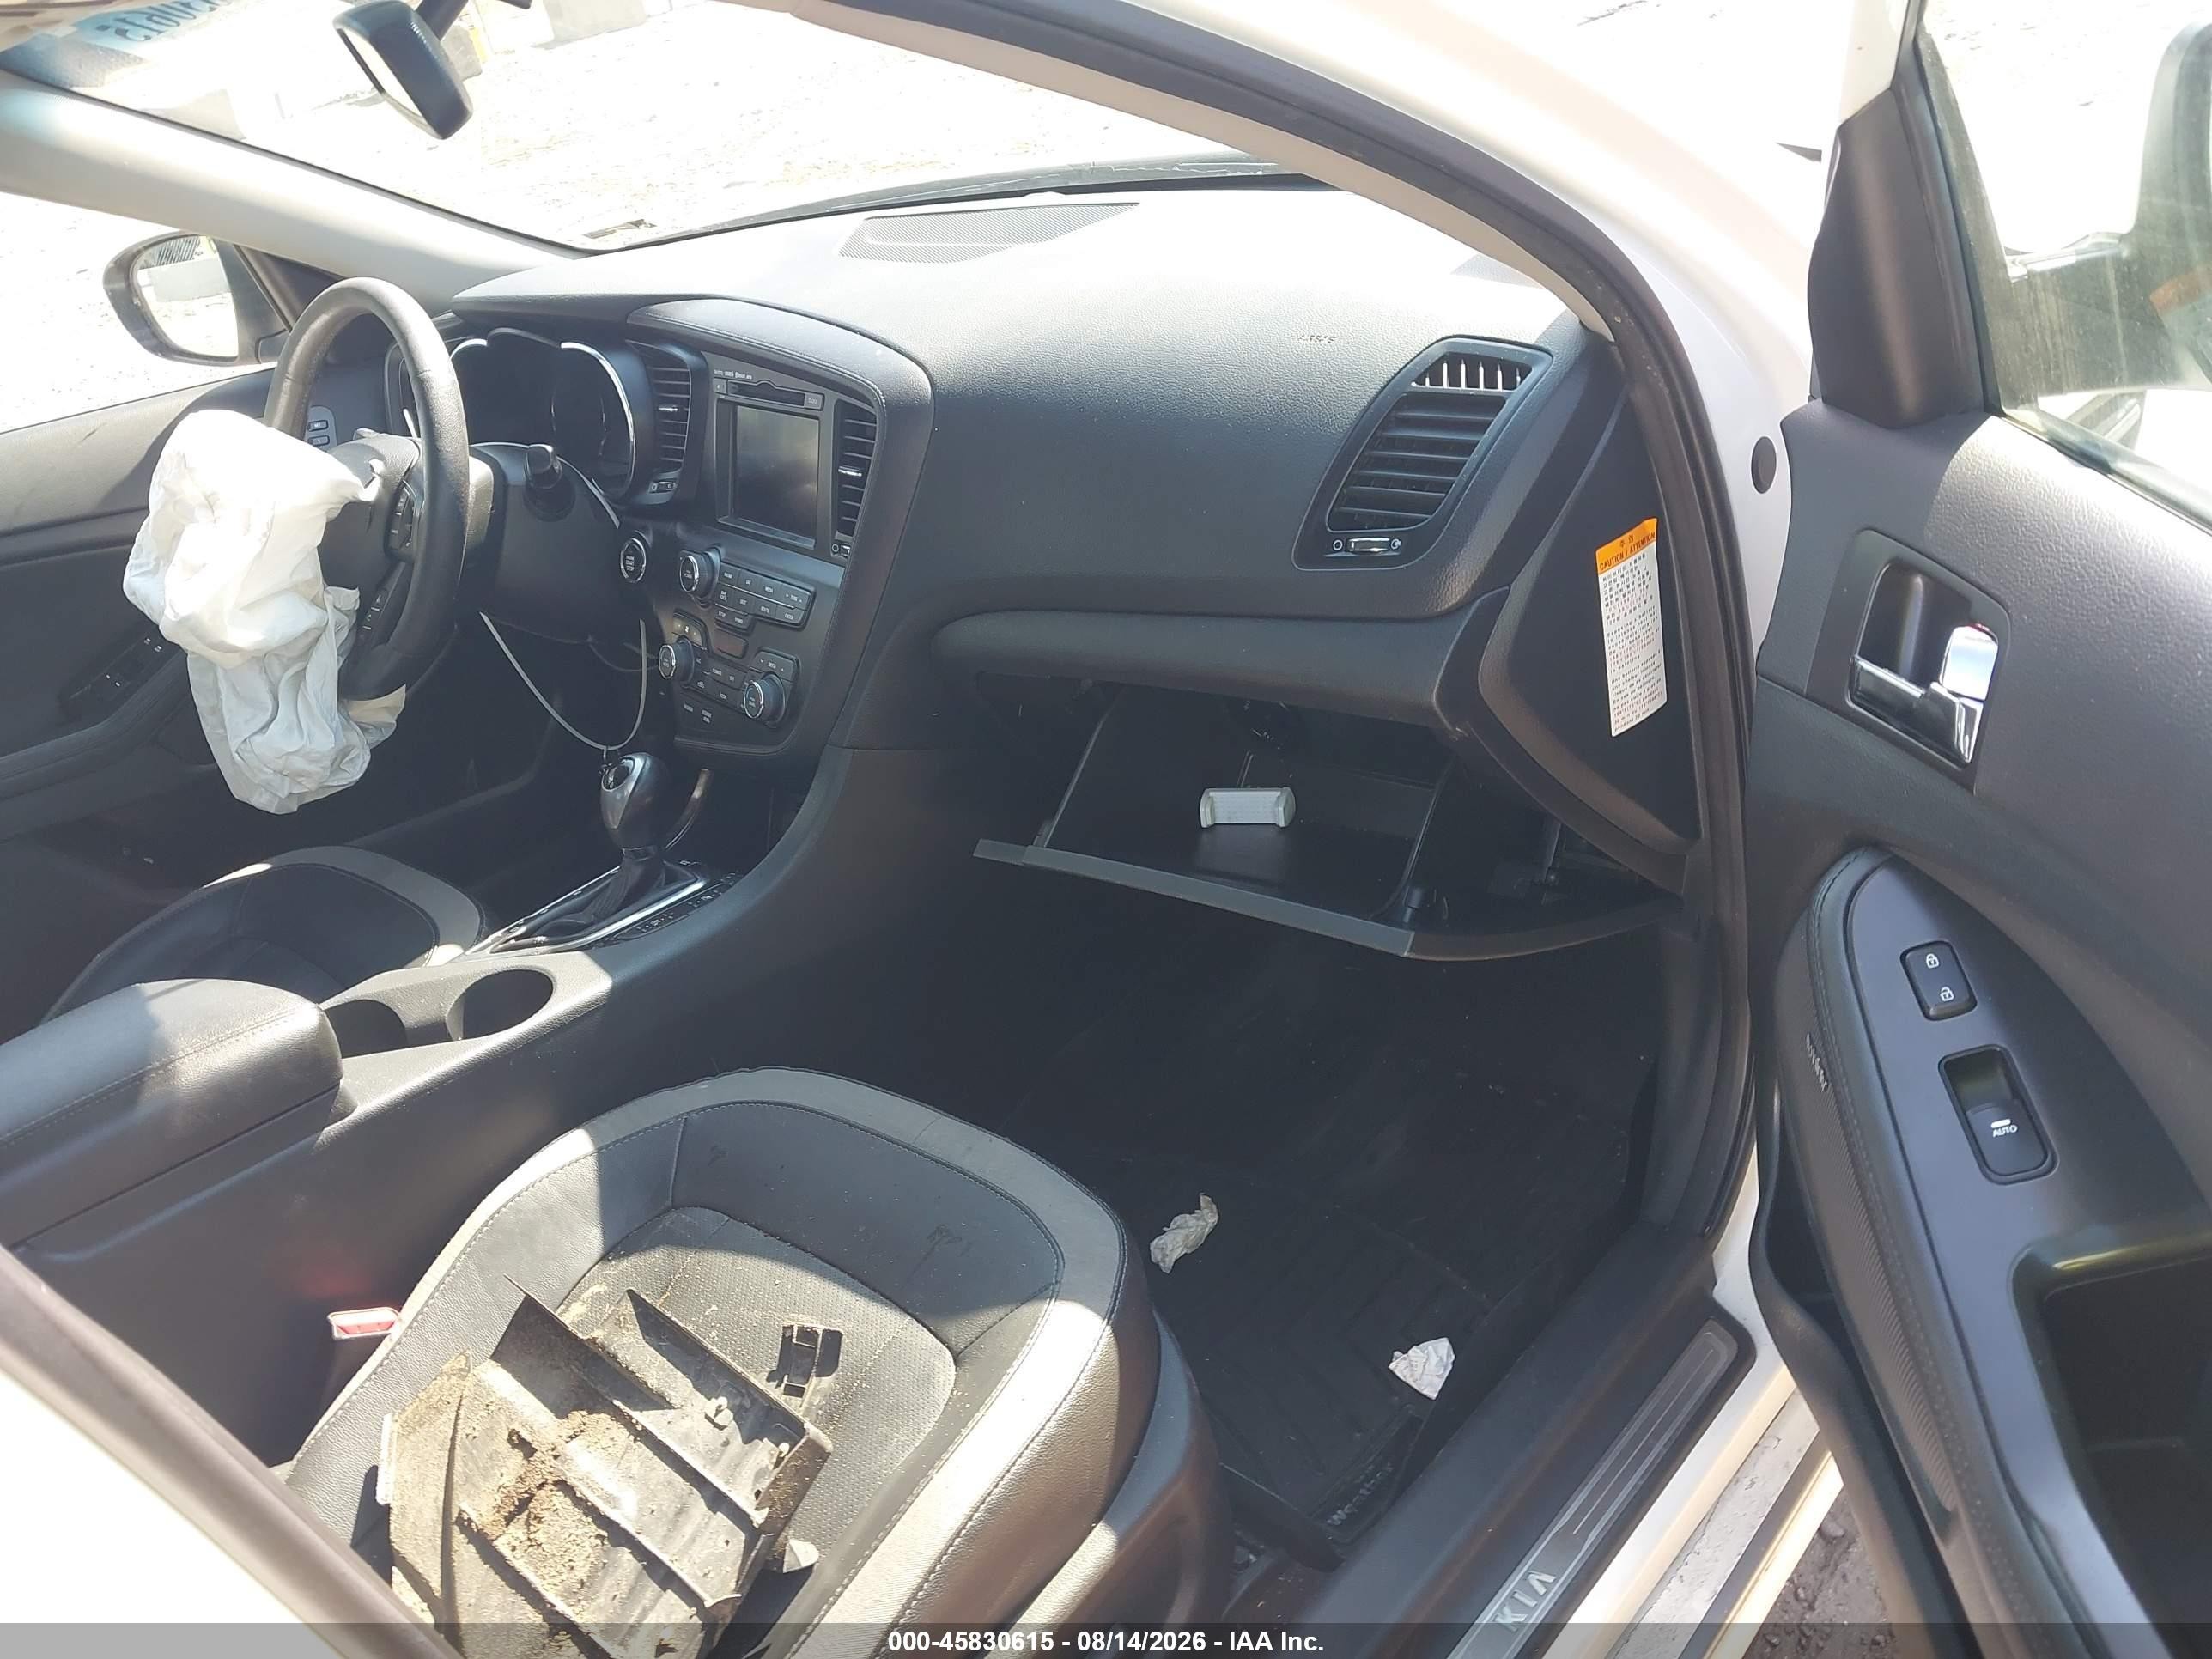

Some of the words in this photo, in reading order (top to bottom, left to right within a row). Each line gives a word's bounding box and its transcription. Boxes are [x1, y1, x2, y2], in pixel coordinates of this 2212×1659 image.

[1599, 550, 1624, 571] CAUTION
[1629, 532, 1655, 554] ATTENTION
[1991, 1124, 2019, 1138] AUTO
[1493, 1570, 1557, 1632] KIA
